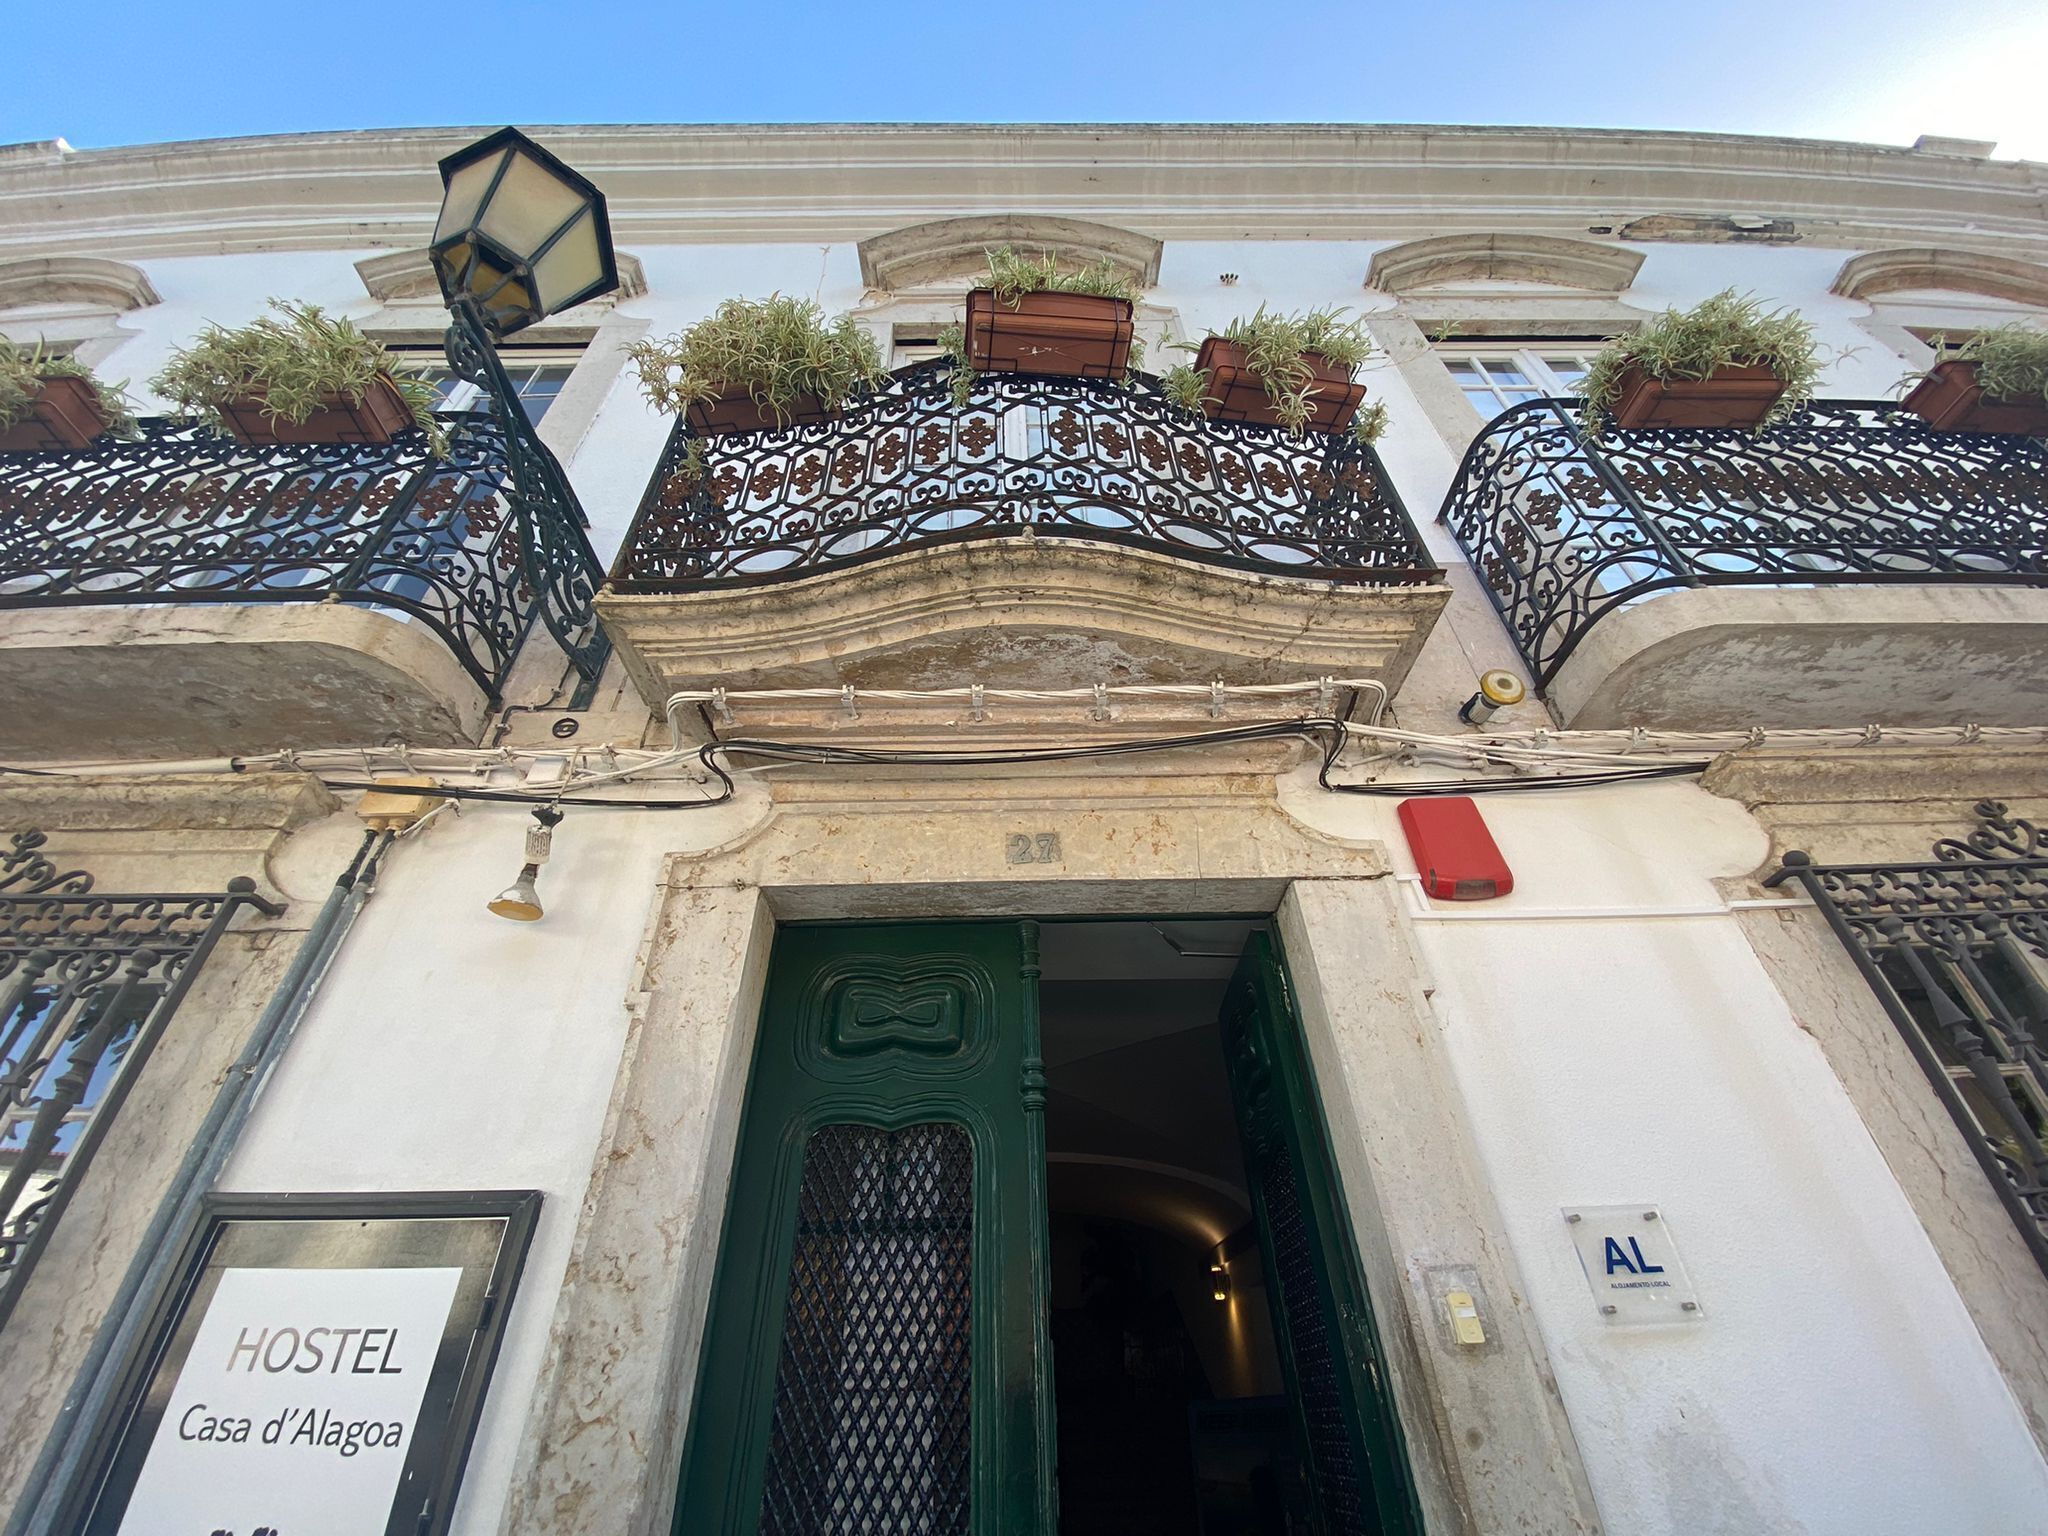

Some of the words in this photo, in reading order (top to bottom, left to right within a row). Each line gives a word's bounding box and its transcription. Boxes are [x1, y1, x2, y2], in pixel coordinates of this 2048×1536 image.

[1009, 833, 1056, 864] 27
[1605, 1236, 1665, 1275] AL
[1611, 1281, 1650, 1289] ALOJAMENTO
[1651, 1280, 1671, 1288] LOCAL
[225, 1326, 403, 1374] HOSTEL
[178, 1403, 250, 1443] Casa
[261, 1406, 404, 1457] d'Alagoa
